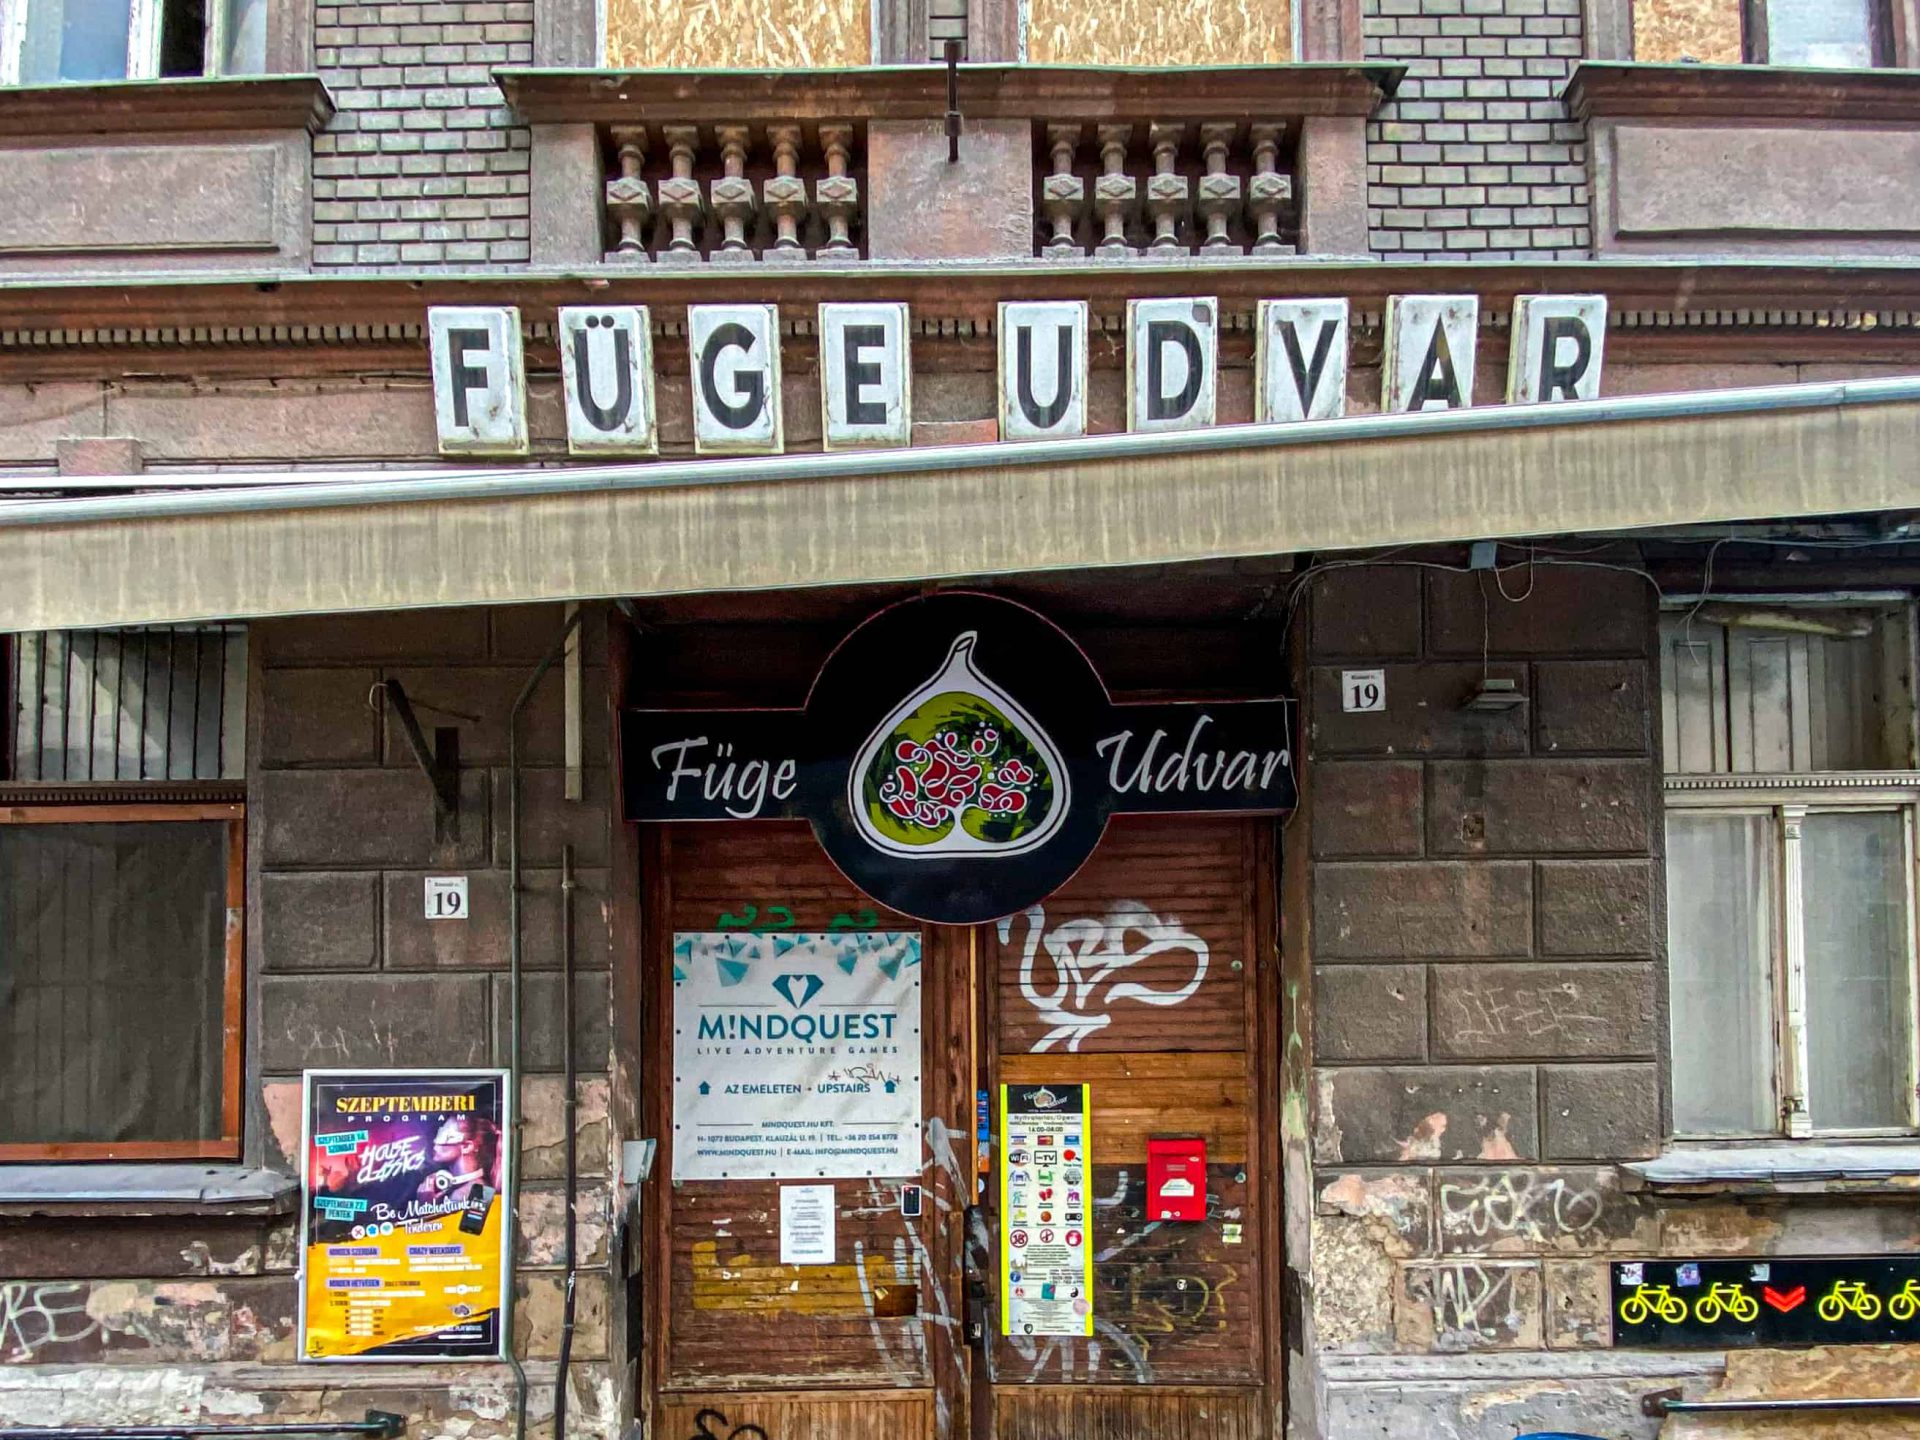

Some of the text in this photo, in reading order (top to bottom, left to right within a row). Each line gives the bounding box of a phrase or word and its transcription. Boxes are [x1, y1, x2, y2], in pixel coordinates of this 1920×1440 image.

[448, 313, 1593, 432] FÜGE UDVAR
[1351, 684, 1379, 709] 19
[651, 714, 1291, 819] Füge Udvar
[433, 892, 461, 916] 19
[698, 1014, 897, 1043] M!NDQUEST
[744, 1047, 836, 1055] ADVENTURE
[849, 1046, 898, 1054] GAMES
[724, 1082, 870, 1094] AZ EMELETEN UPSTAIRS
[336, 1095, 476, 1113] SZEPTEMBERI
[347, 1114, 466, 1123] PROGRAM
[761, 1120, 819, 1129] MINDQUEST.HU
[765, 1132, 797, 1142] KLAUZÁL
[358, 1135, 420, 1165] HOUSE
[815, 1147, 898, 1156] INFO@MINDQUEST.HU
[357, 1149, 425, 1184] CLASSICS
[316, 1199, 354, 1209] SZEPTEMBER
[370, 1203, 395, 1220] Be
